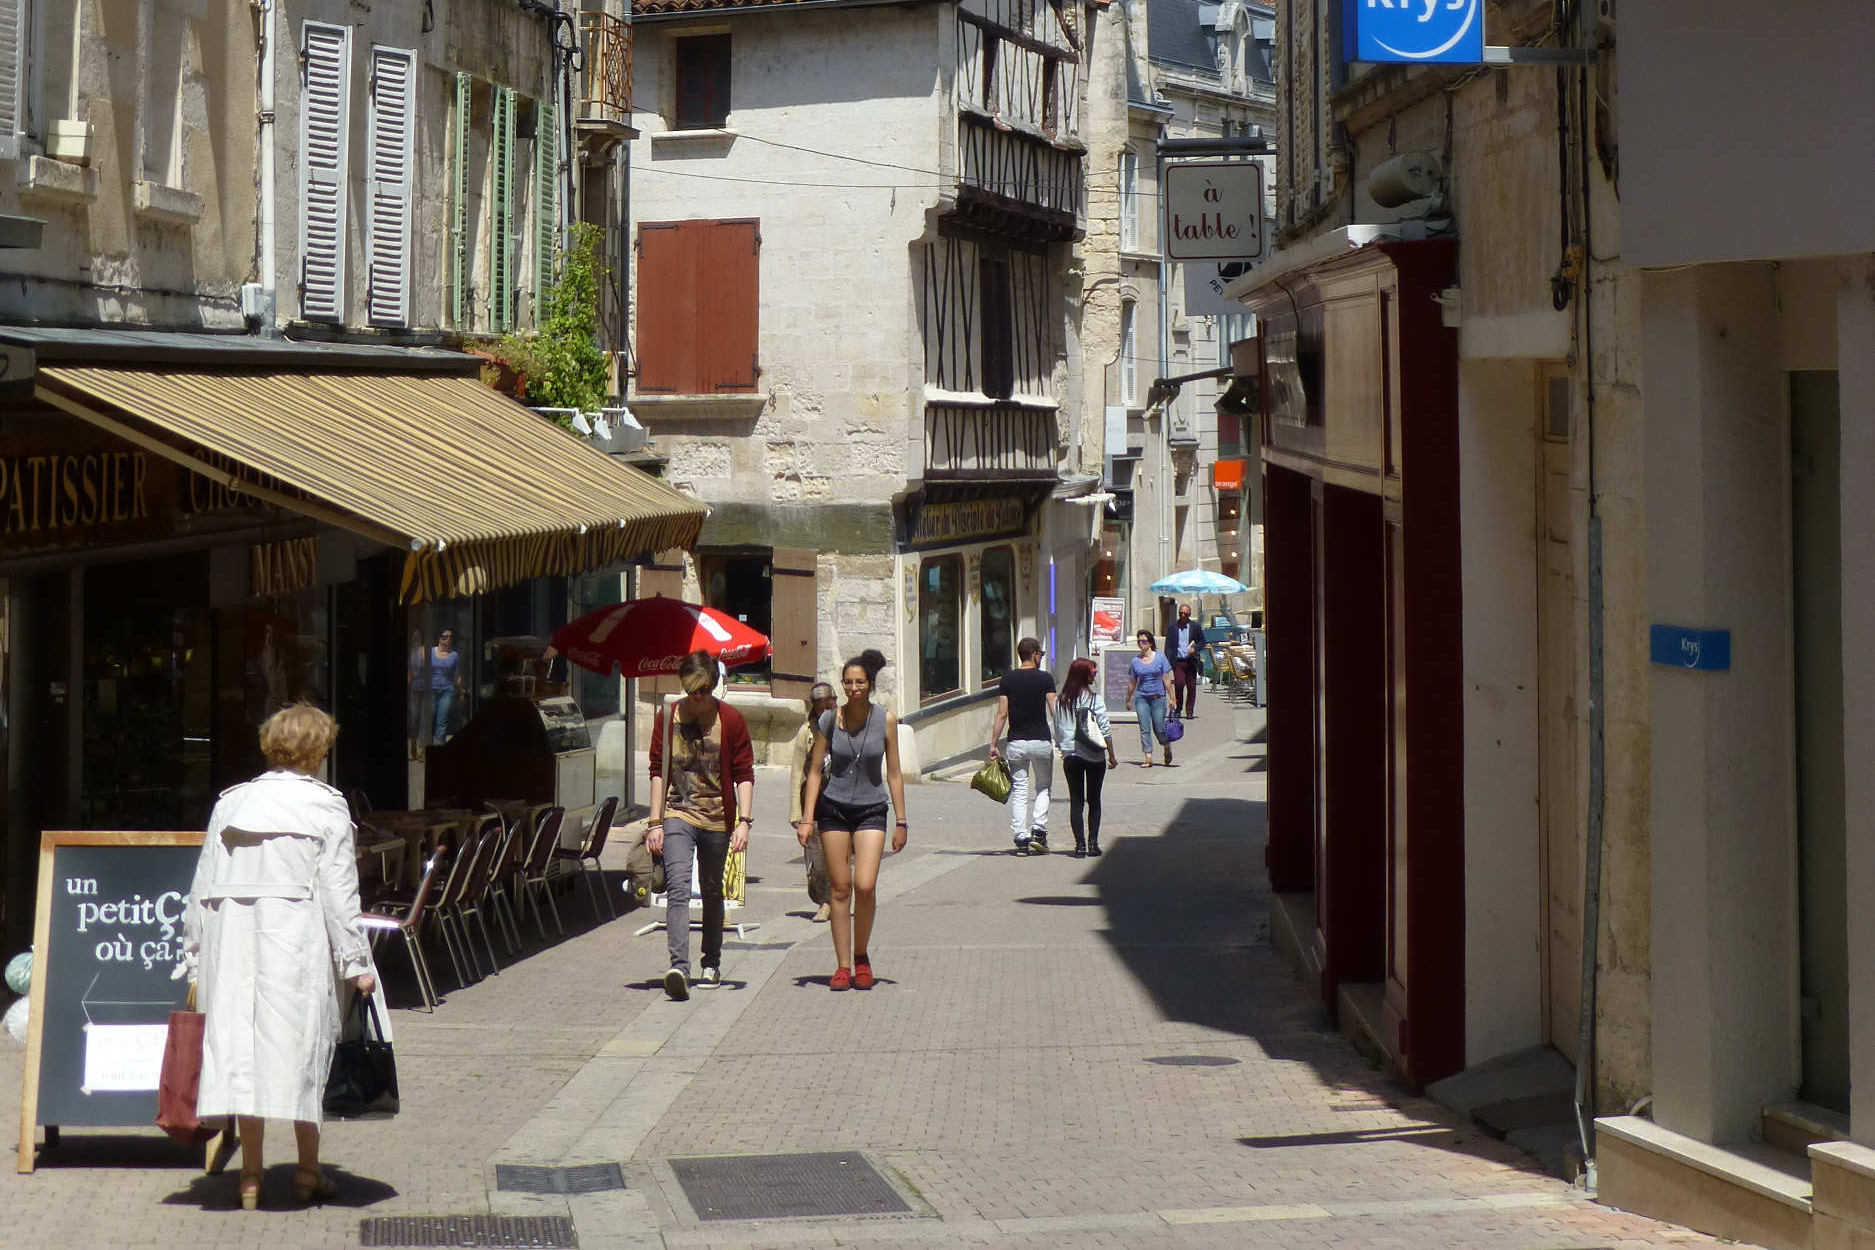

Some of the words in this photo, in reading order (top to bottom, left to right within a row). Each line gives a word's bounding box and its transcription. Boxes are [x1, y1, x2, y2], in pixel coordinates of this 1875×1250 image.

[1203, 179, 1224, 203] à
[1174, 213, 1240, 240] table
[1249, 213, 1257, 239] !
[1681, 637, 1698, 657] Krys
[66, 877, 98, 895] un
[95, 932, 133, 961] où
[140, 941, 173, 970] ça
